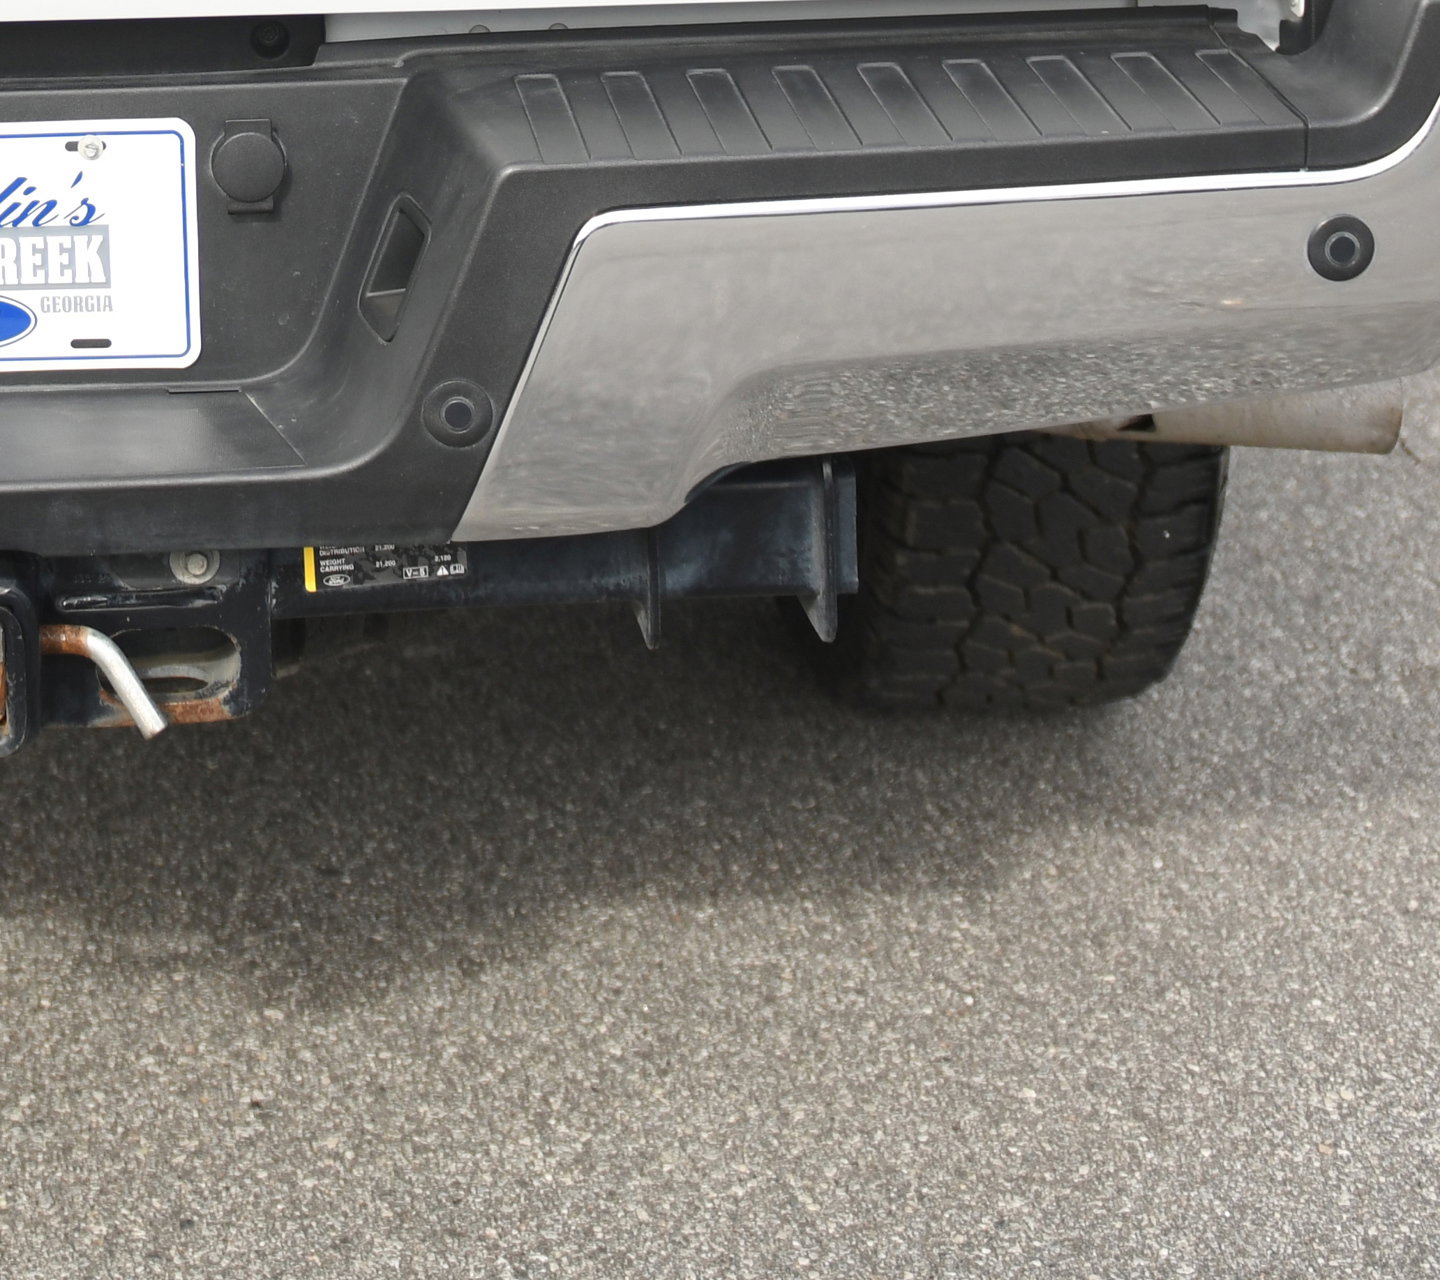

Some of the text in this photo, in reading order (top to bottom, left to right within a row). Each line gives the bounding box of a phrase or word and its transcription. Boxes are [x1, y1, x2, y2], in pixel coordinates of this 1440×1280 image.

[40, 294, 114, 315] GEORGIA
[320, 558, 346, 566] WEIGHT
[320, 564, 355, 573] CARRYING
